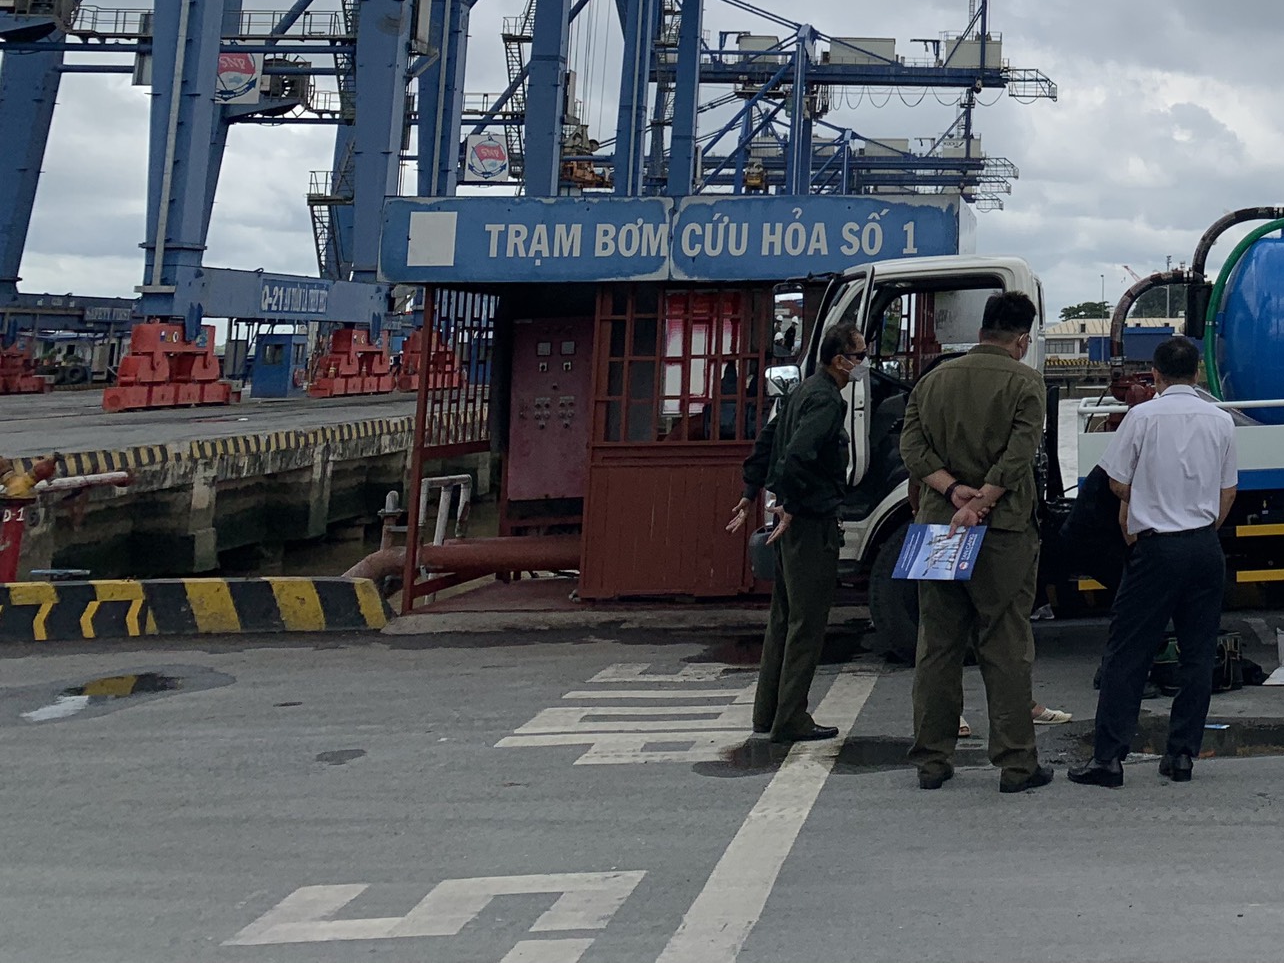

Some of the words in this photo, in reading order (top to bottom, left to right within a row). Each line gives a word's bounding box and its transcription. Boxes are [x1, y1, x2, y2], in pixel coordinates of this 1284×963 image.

[484, 223, 582, 267] TRẠM
[594, 217, 669, 258] BƠM
[681, 212, 749, 257] CỨU
[760, 207, 829, 256] HỎA
[839, 208, 890, 256] SỐ
[902, 221, 918, 254] 1
